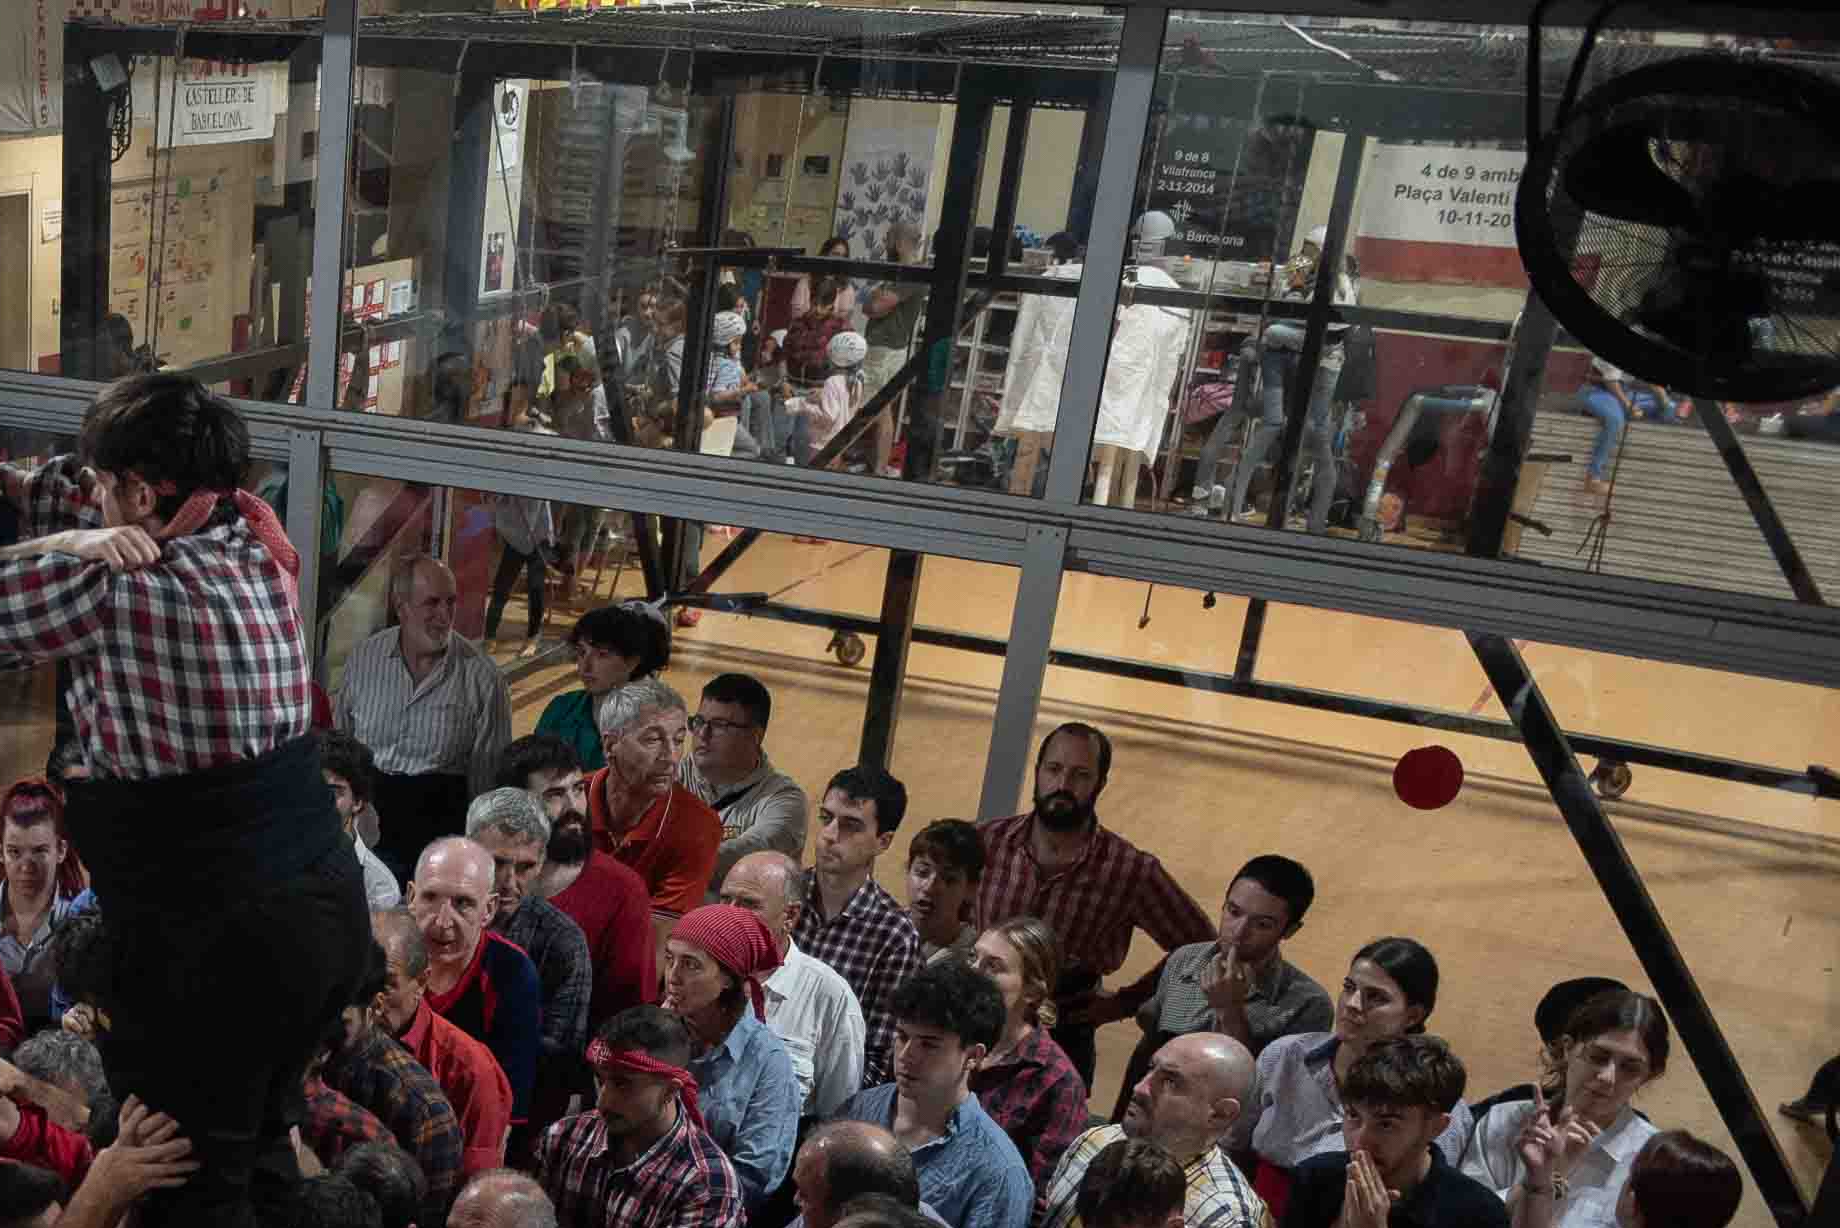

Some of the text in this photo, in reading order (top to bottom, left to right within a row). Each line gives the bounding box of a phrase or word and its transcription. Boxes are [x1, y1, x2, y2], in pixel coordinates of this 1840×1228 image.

[1175, 149, 1183, 161] 9
[1185, 151, 1199, 162] de
[1162, 164, 1216, 179] Vilafranca
[1421, 163, 1520, 183] 4 de 9 amb
[1394, 183, 1443, 206] Plaça
[1438, 209, 1512, 228] 10-11-20
